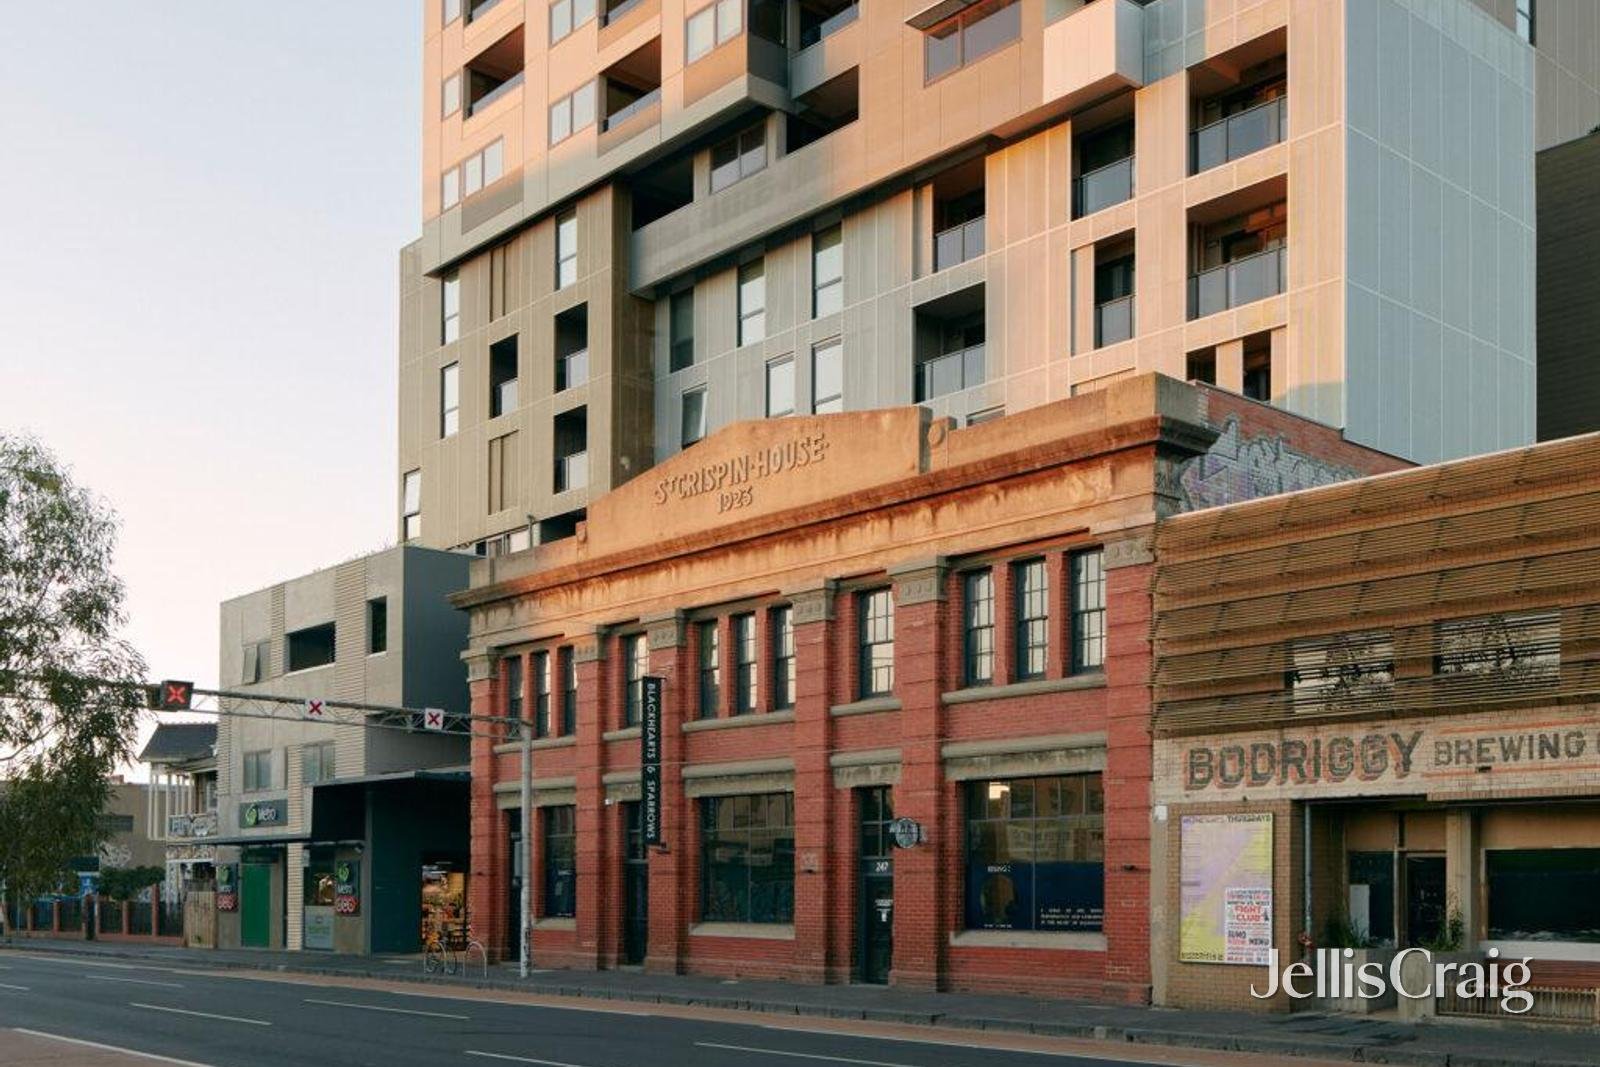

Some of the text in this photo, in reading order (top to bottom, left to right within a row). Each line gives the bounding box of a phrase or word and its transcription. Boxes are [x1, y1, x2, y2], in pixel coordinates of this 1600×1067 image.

[646, 683, 657, 758] BLACKHEARTS
[1185, 730, 1425, 791] BODRIGGY
[1434, 731, 1586, 766] BREWING
[646, 780, 657, 839] SPARROWS
